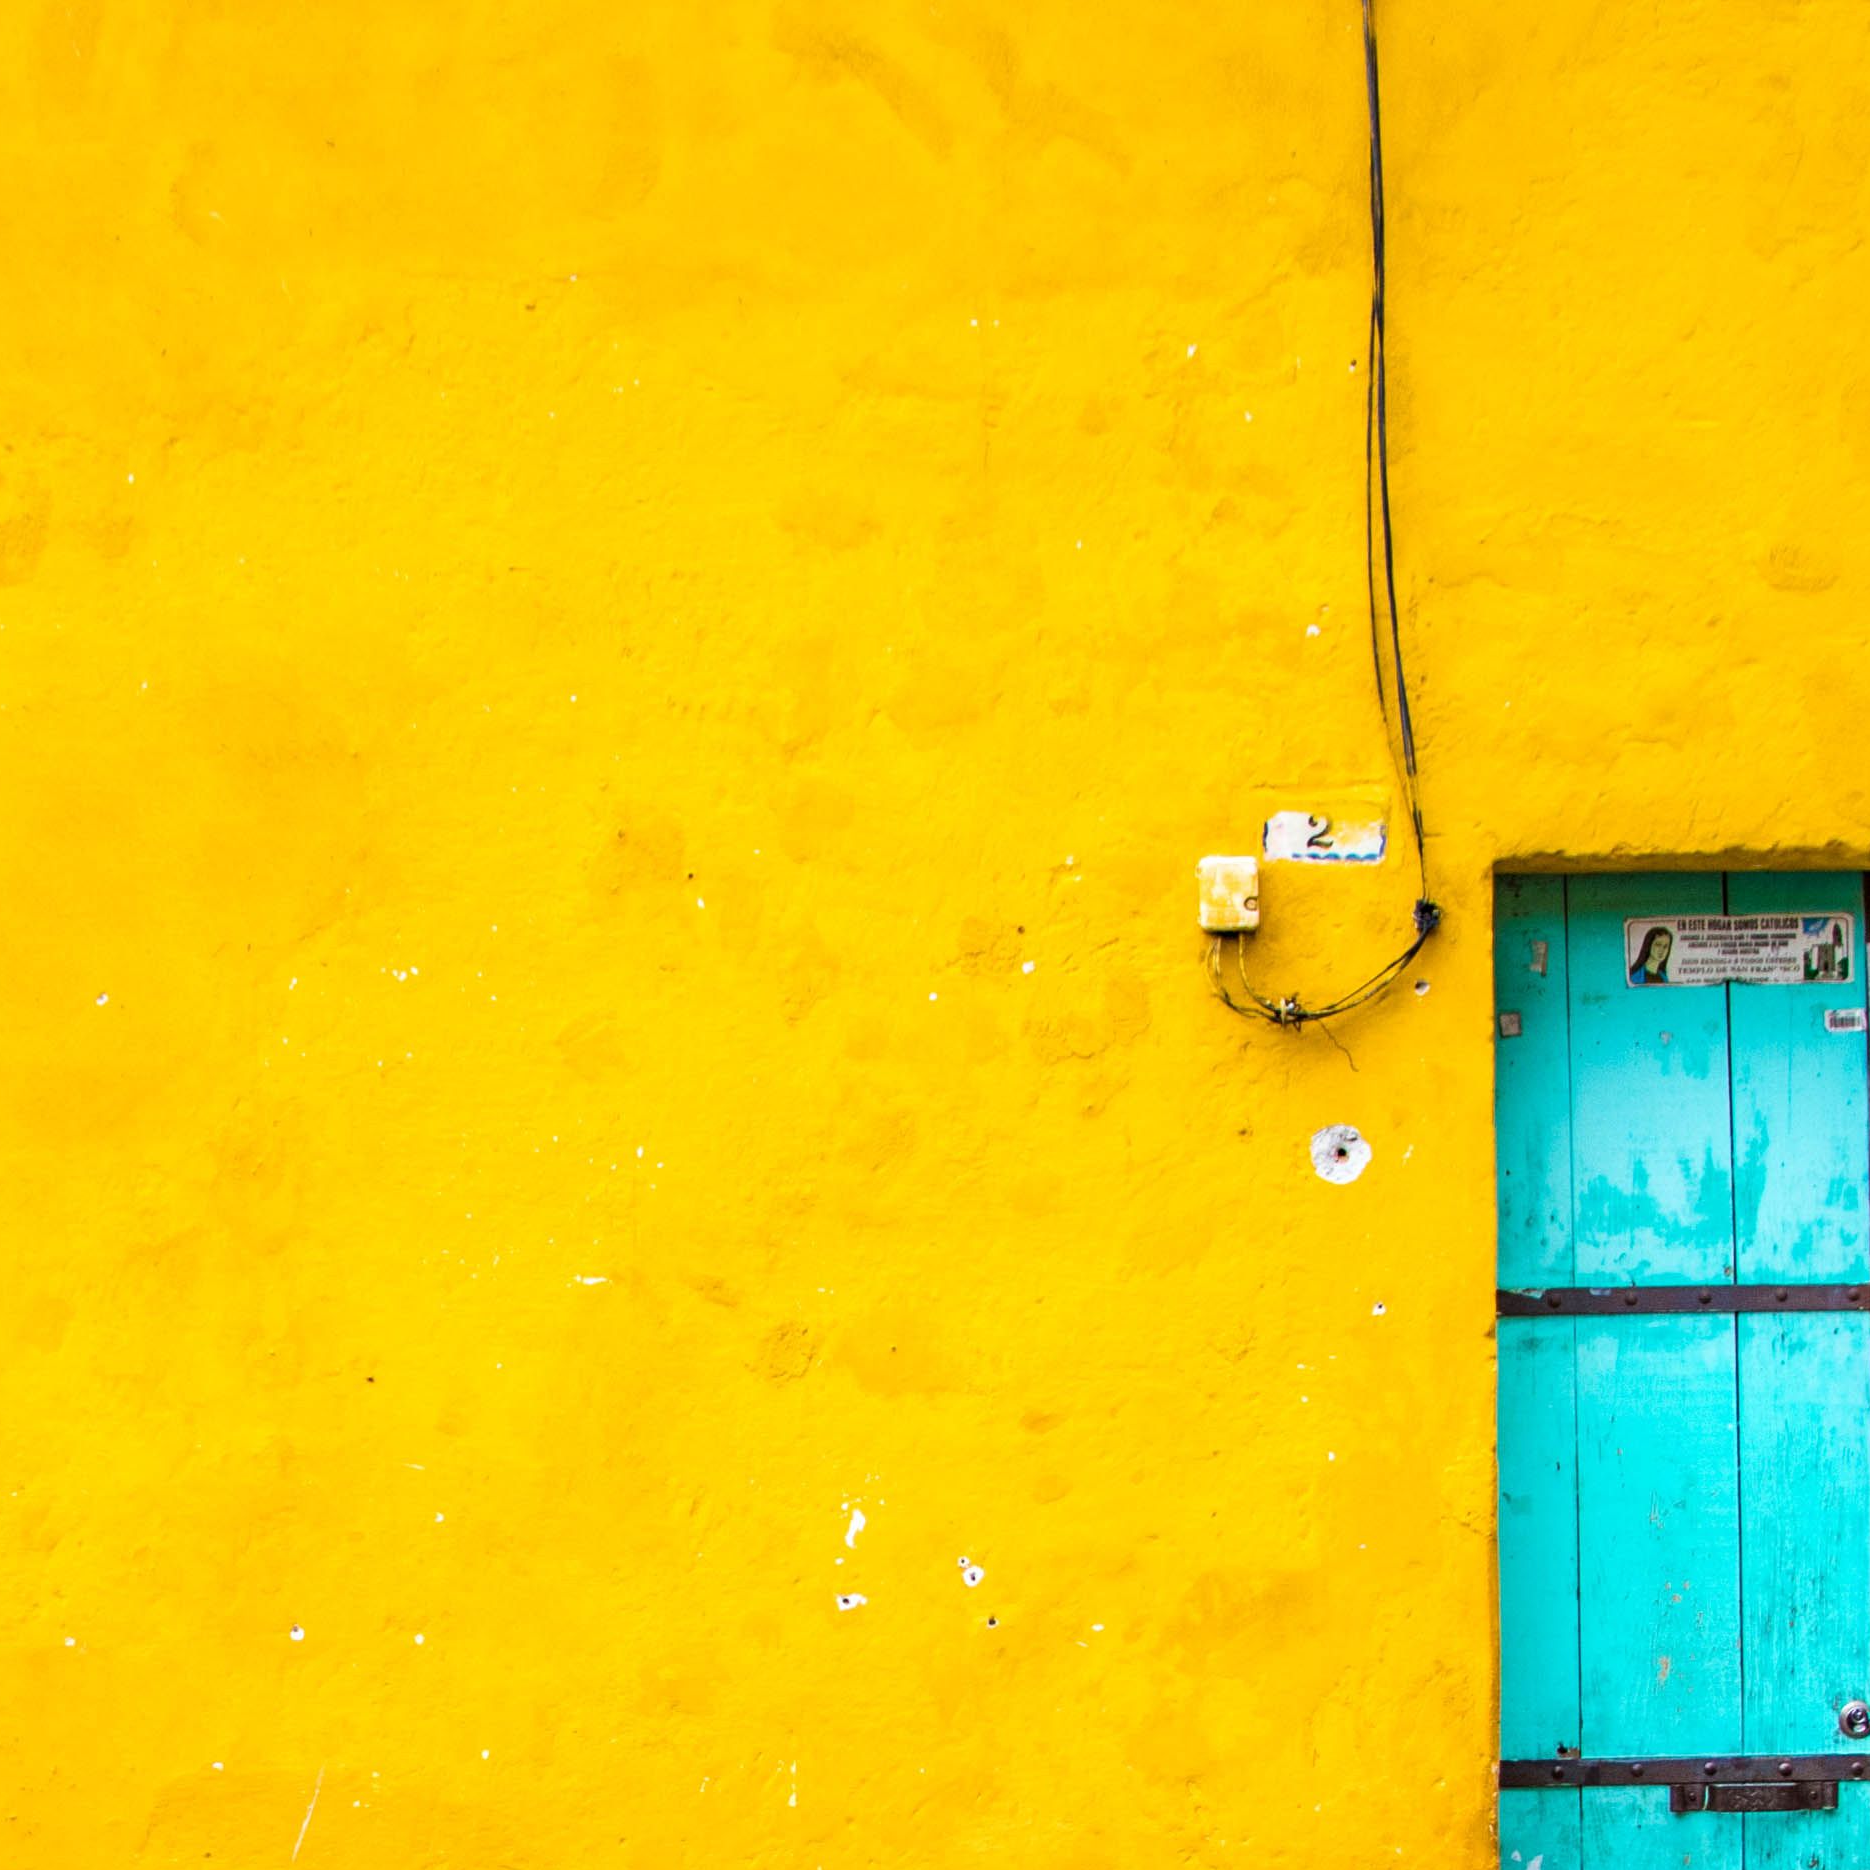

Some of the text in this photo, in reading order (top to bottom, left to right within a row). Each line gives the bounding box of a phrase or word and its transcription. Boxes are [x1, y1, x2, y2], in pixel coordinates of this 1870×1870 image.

[1307, 815, 1333, 848] 2
[1677, 919, 1687, 931] EN
[1689, 919, 1706, 931] ESTE
[1707, 919, 1732, 931] HOGAR
[1734, 918, 1758, 930] SOMOS
[1678, 966, 1714, 975] TEMPLO
[1716, 965, 1728, 973] DE
